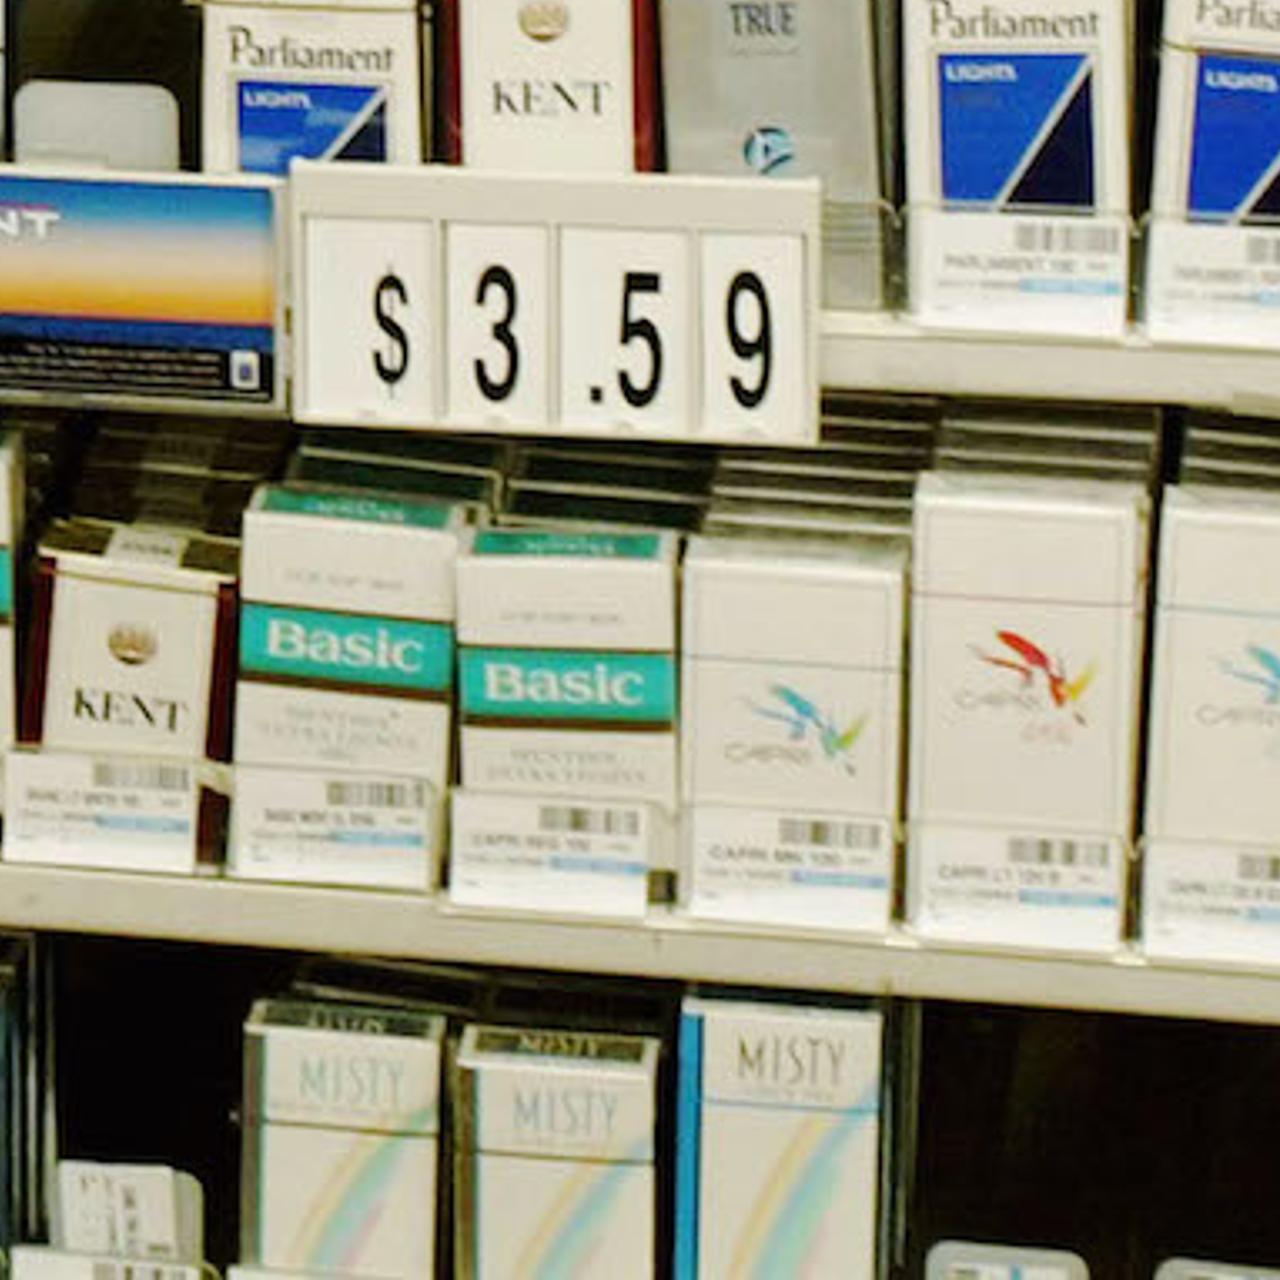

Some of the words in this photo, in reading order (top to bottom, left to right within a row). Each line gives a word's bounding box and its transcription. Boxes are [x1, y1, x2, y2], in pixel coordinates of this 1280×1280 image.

[729, 2, 798, 38] TRUE
[228, 25, 395, 73] Parliament
[945, 62, 1017, 82] LIGHTS
[242, 89, 312, 109] LIGHTS
[492, 80, 612, 117] KENT
[267, 619, 425, 674] Basic
[484, 661, 645, 707] Basic
[73, 687, 188, 733] KENT
[299, 1056, 405, 1106] MISTY
[738, 1034, 847, 1088] MISTY
[513, 1088, 620, 1139] MISTY
